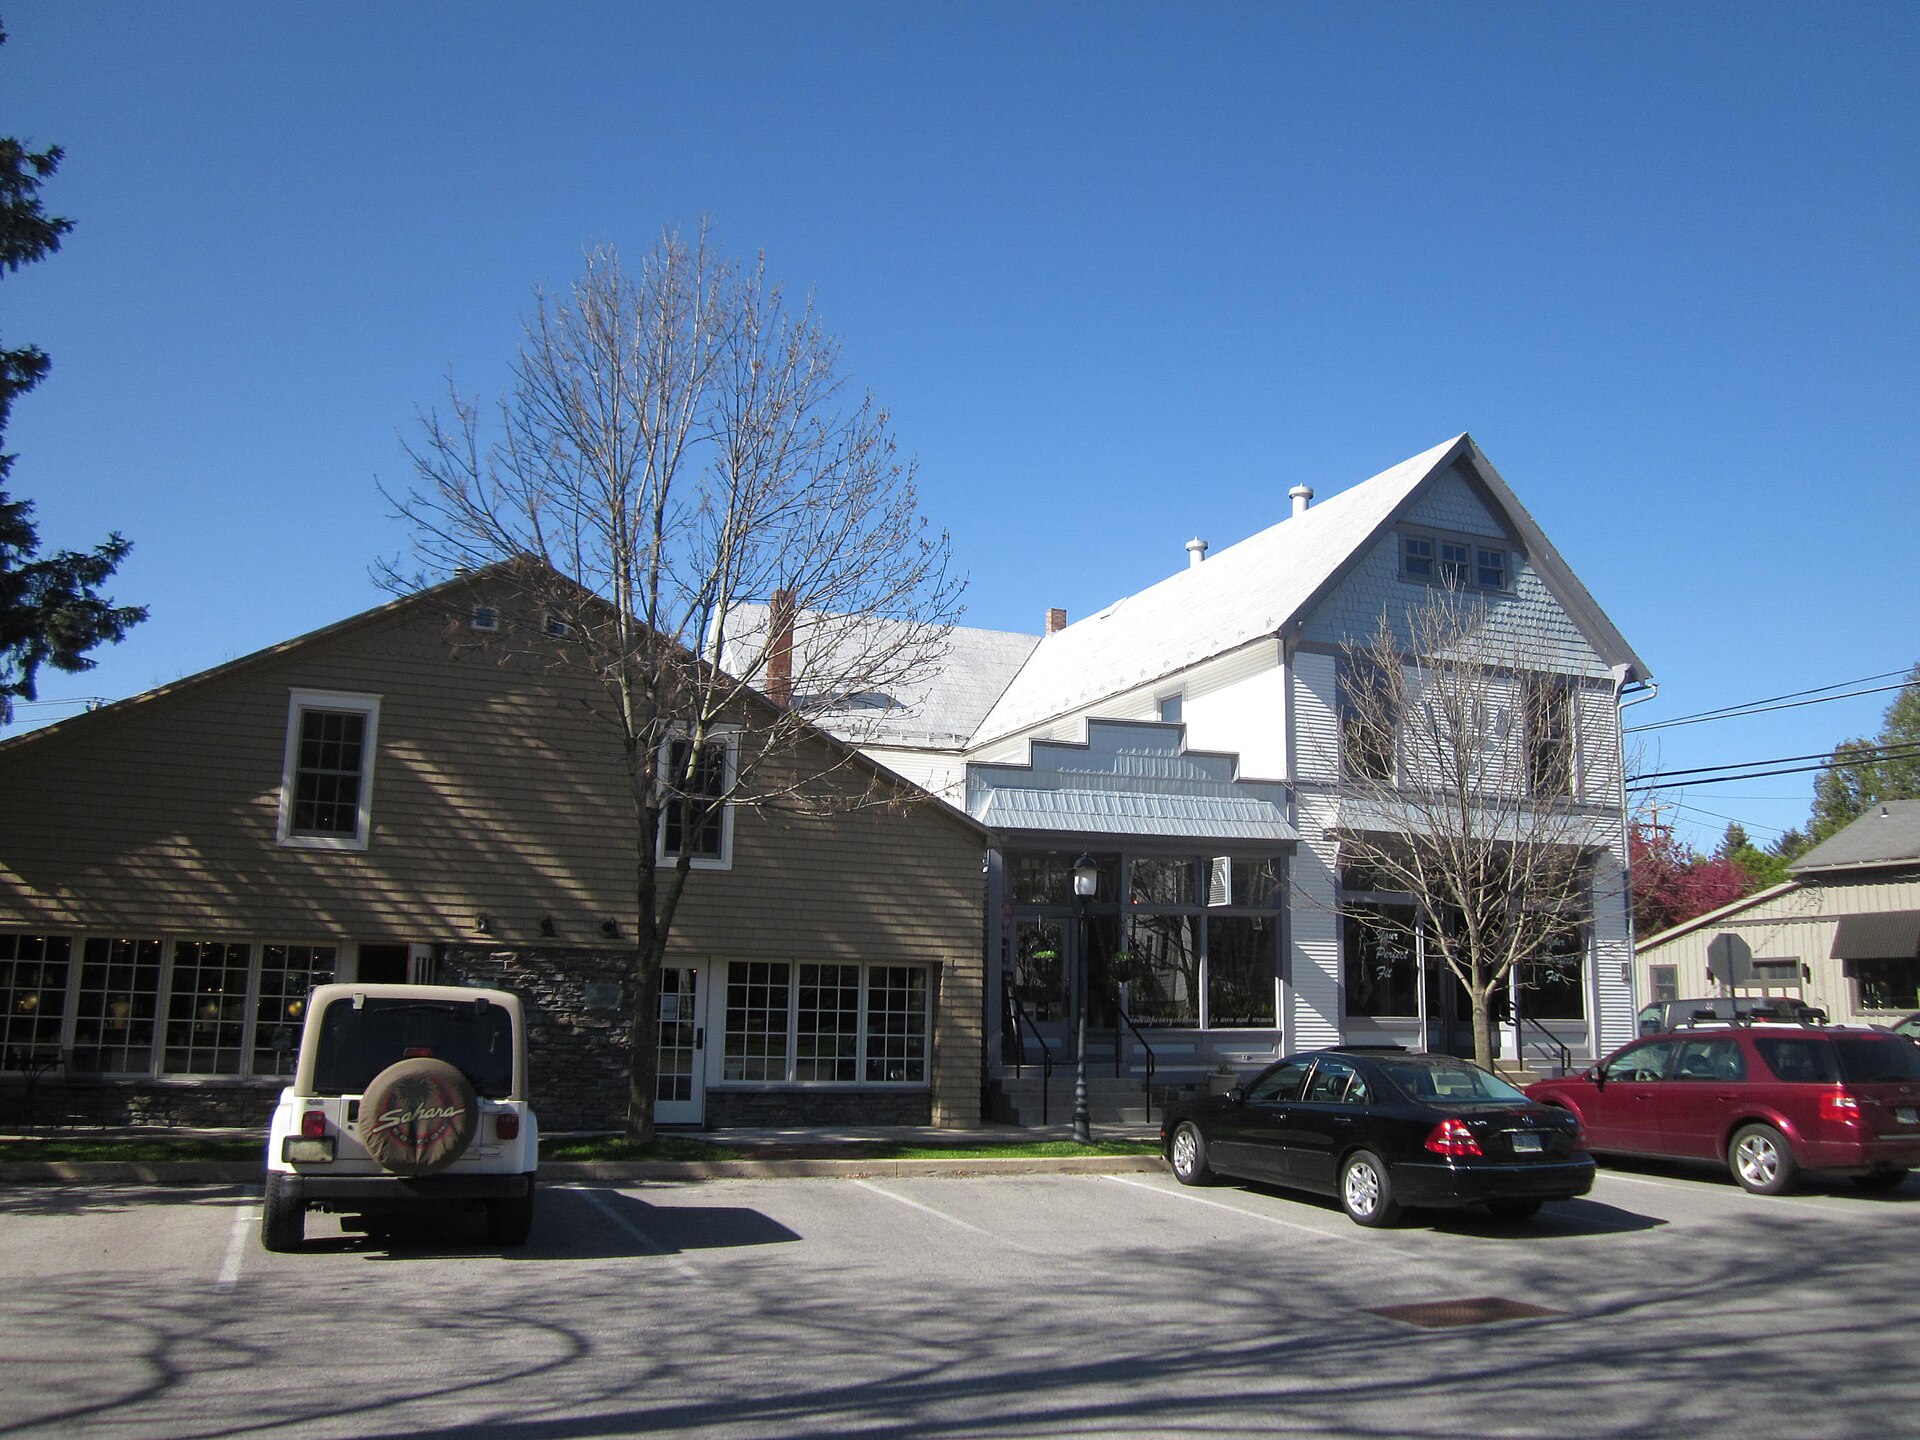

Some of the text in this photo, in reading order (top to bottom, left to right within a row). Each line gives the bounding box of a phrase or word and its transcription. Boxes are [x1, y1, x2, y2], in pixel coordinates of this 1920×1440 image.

[1375, 946, 1410, 963] Perfect
[1376, 966, 1393, 981] Fit
[373, 1101, 466, 1134] Sahara
